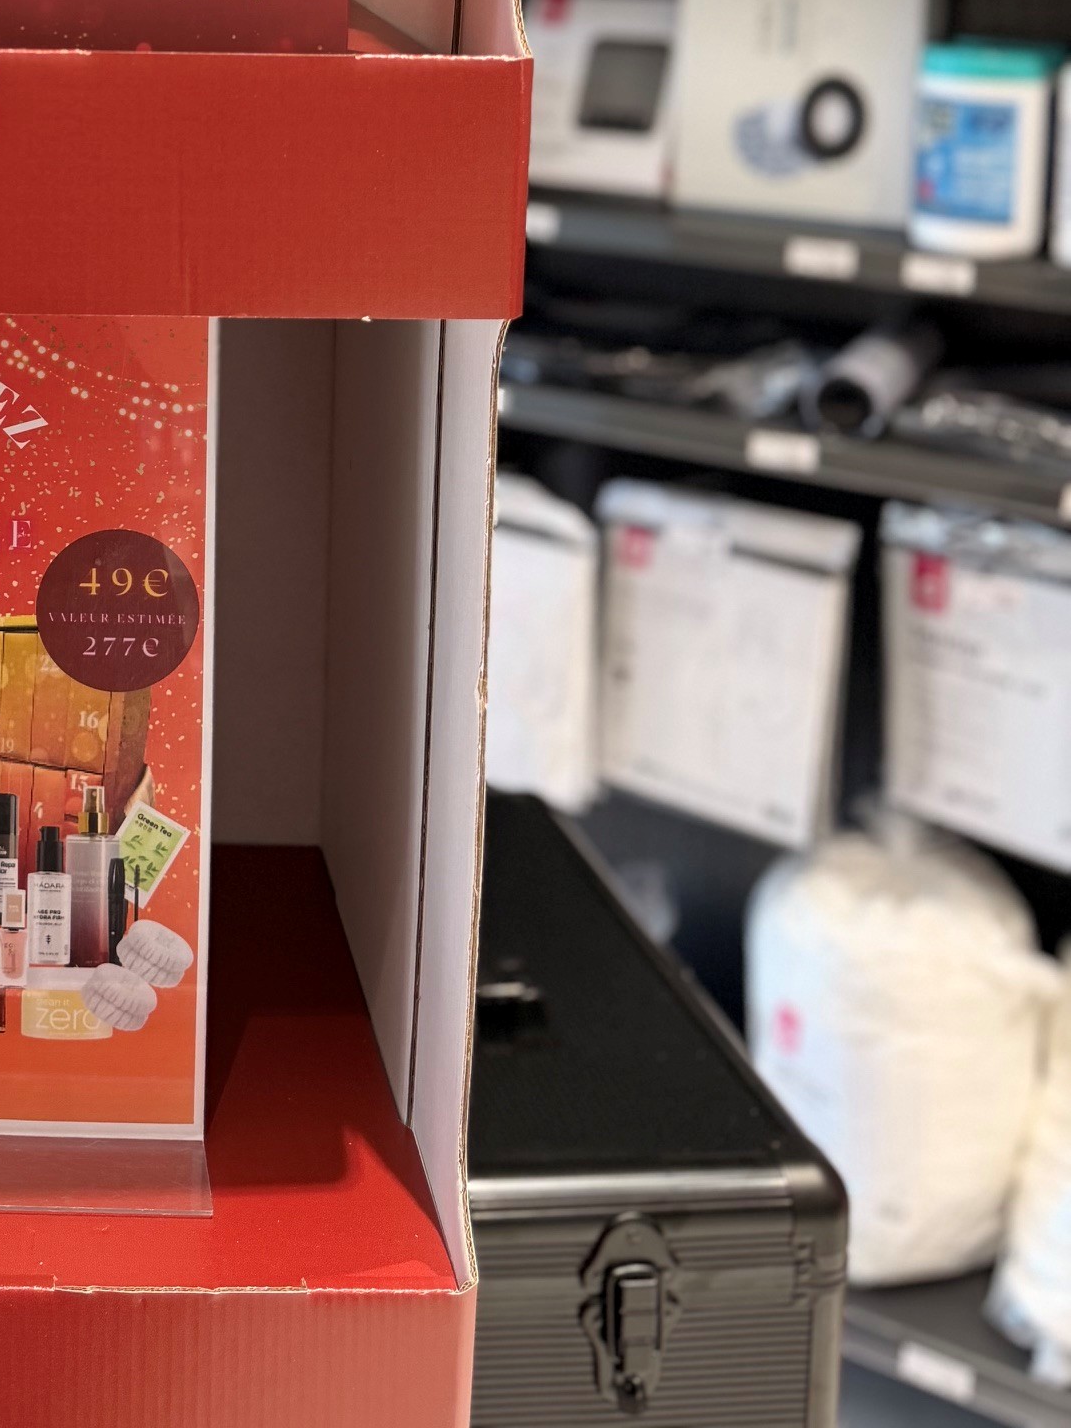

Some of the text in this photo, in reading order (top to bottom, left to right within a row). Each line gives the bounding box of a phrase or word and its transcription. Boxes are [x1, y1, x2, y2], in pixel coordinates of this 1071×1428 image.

[48, 612, 187, 625] VALEUR ESTIMÉE
[82, 635, 160, 658] 277€
[137, 813, 159, 830] Green
[159, 825, 172, 838] Tea
